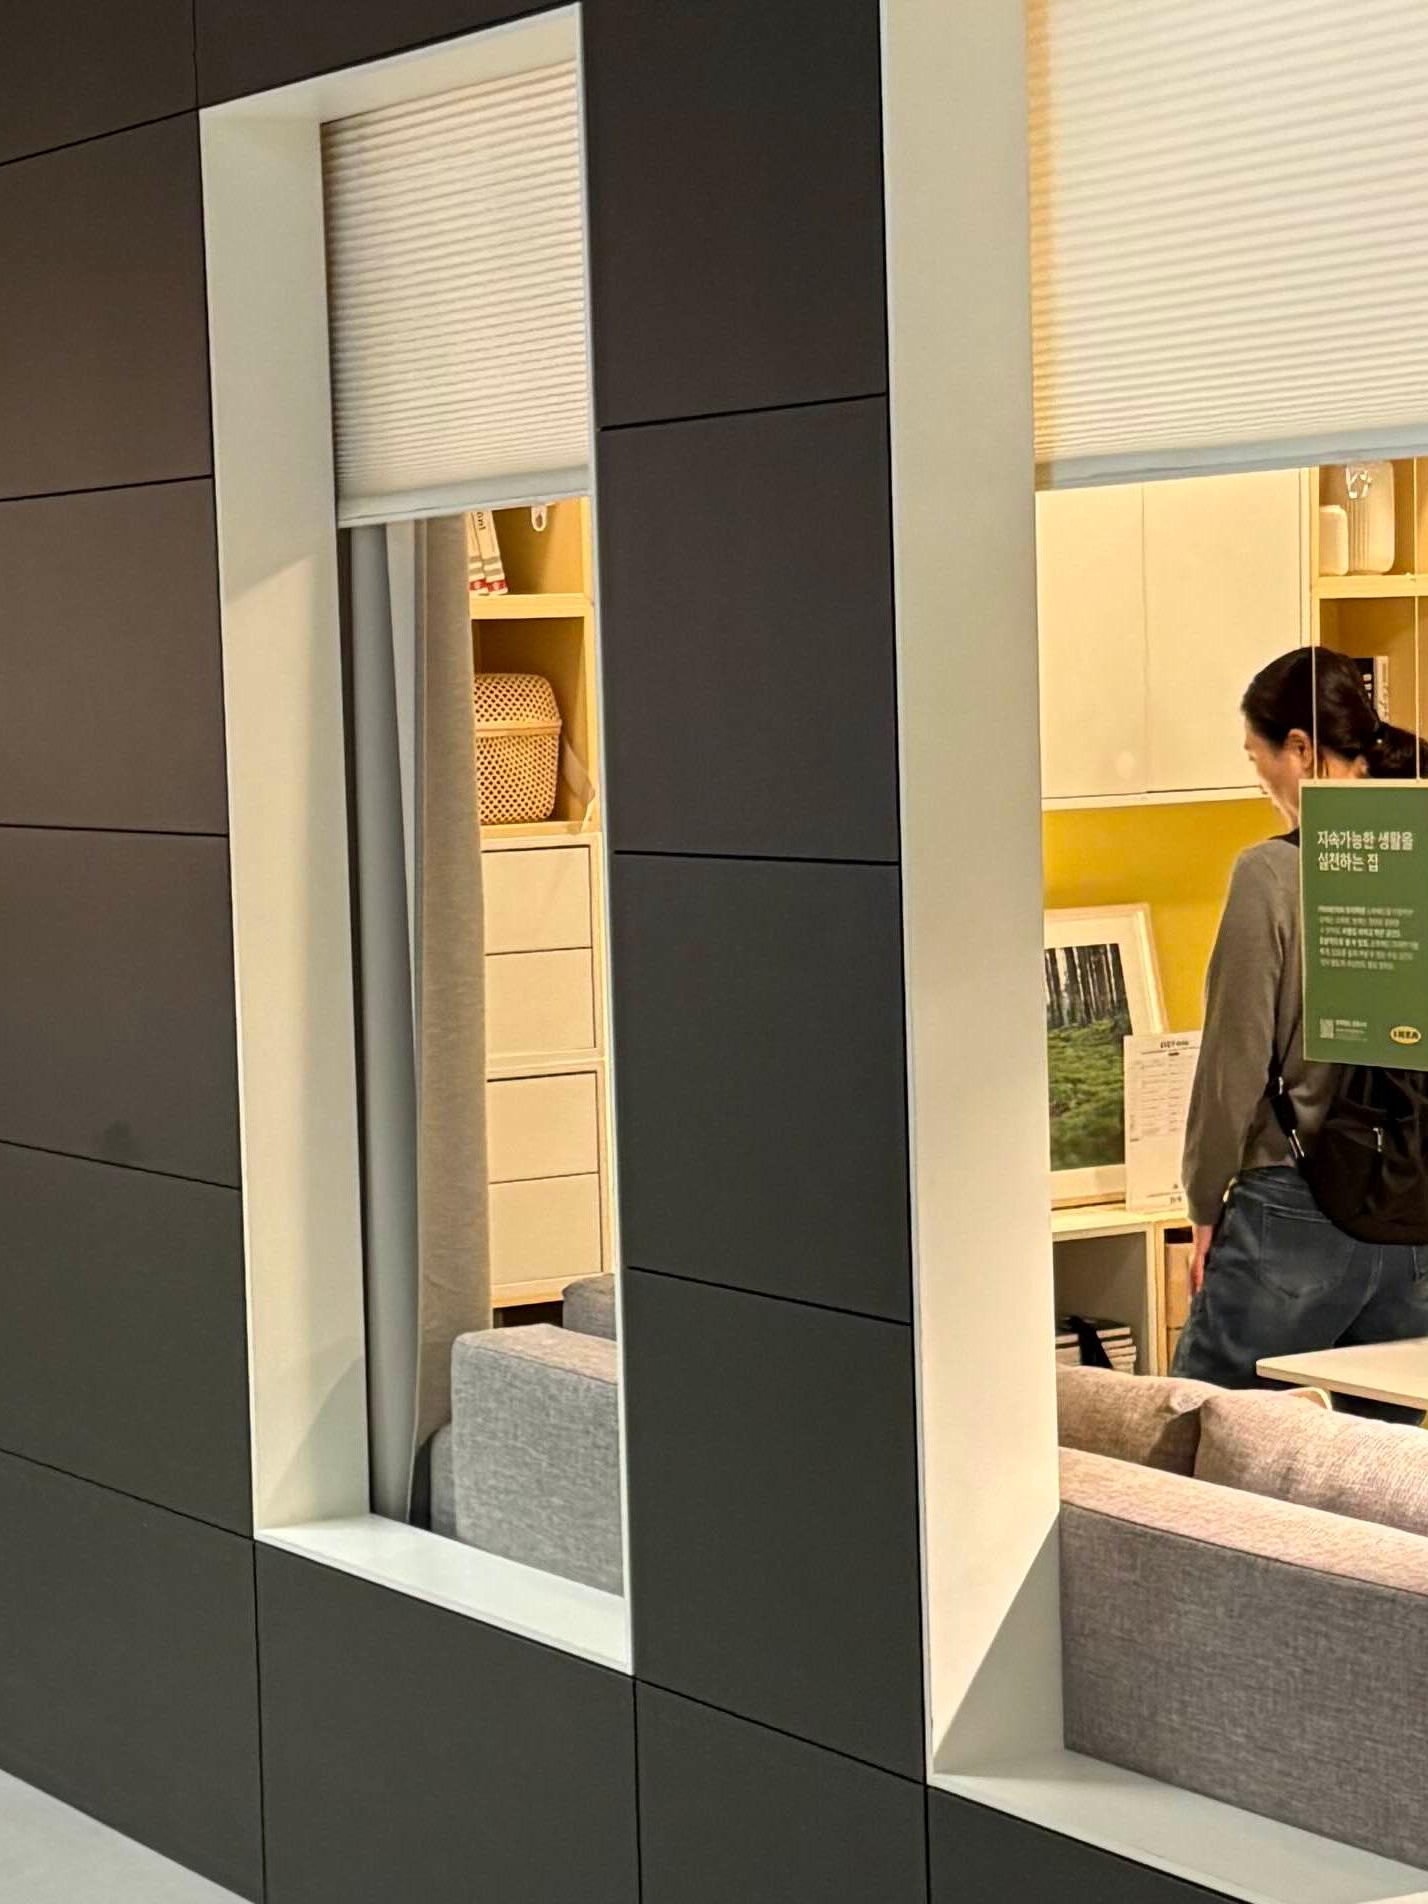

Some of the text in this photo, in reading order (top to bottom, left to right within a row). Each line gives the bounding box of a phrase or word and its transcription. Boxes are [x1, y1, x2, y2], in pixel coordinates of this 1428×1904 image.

[1316, 829, 1414, 851] 지속가능한 생활을
[1317, 852, 1380, 873] 실천하는 집
